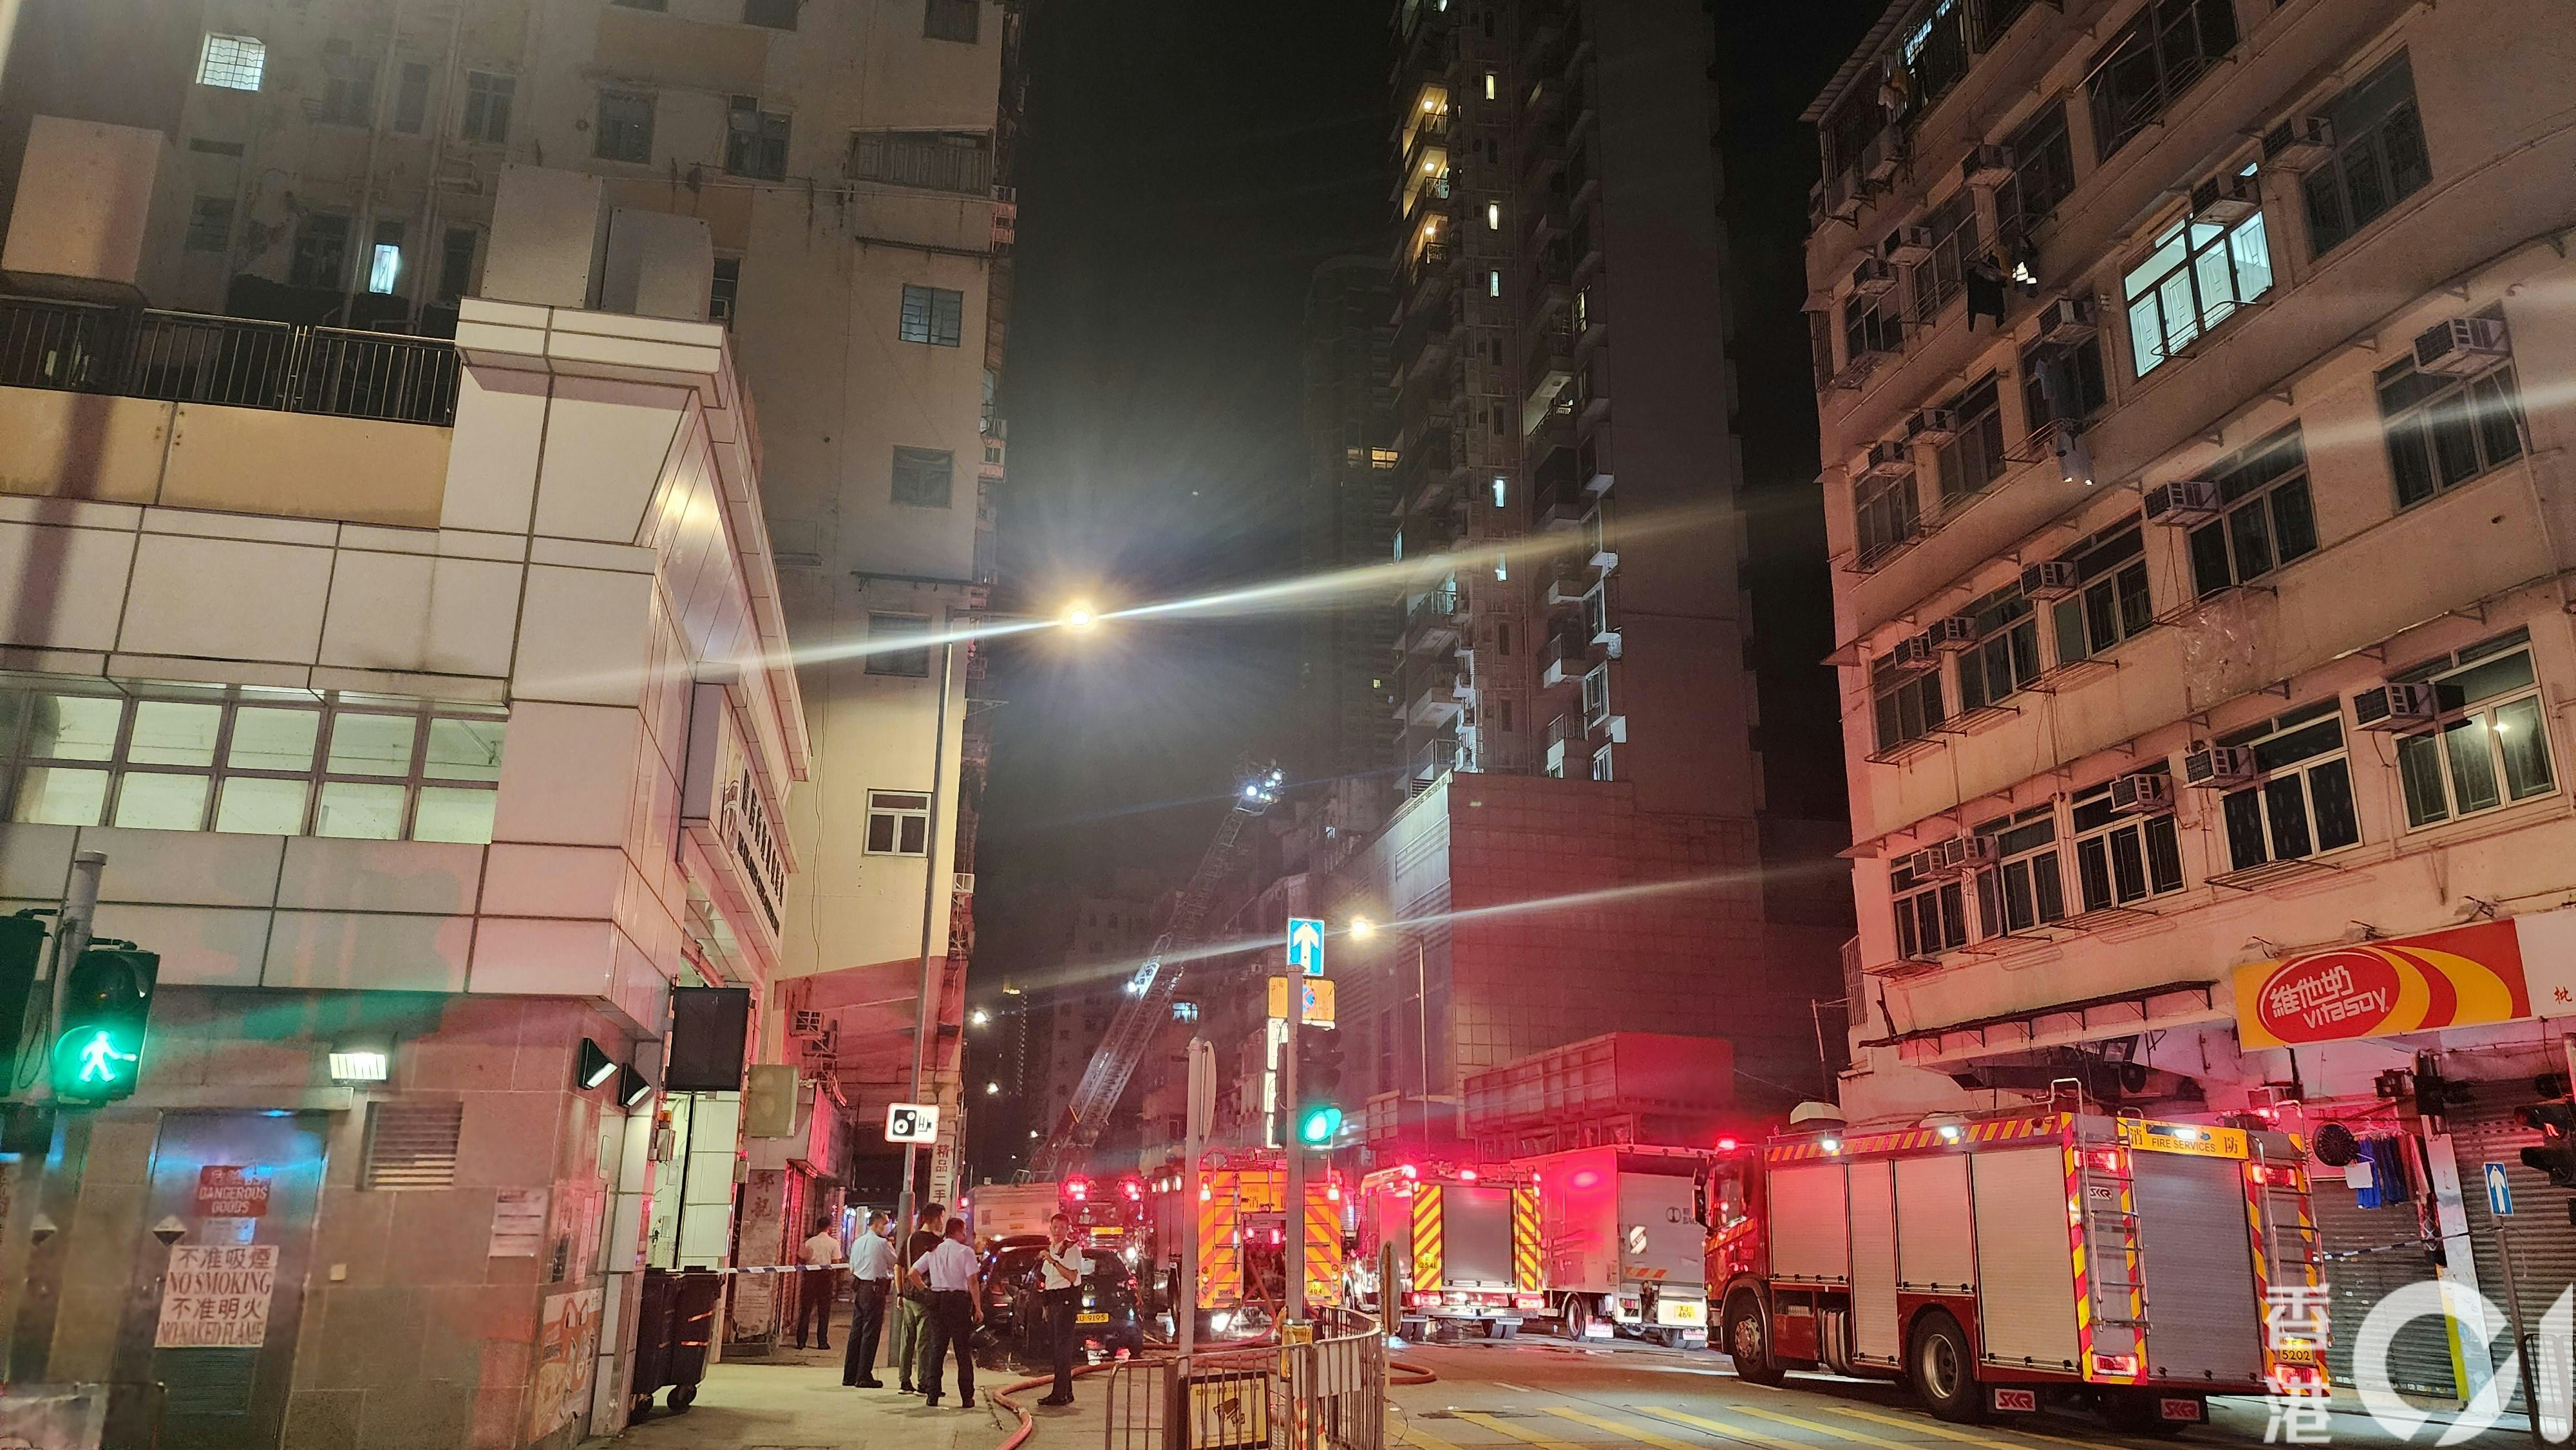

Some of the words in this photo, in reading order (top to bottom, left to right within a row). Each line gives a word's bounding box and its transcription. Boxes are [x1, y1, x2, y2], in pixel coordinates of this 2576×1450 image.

[2270, 965, 2354, 1018] 維他奶
[2303, 986, 2386, 1029] vitasoy
[2130, 1127, 2143, 1145] 消
[2224, 1136, 2238, 1154] 防
[2152, 1138, 2170, 1149] FIRE
[2174, 1140, 2216, 1153] SERVICES
[933, 1144, 950, 1203] 精品二手
[198, 1187, 268, 1201] DANGEROUS
[211, 1201, 251, 1214] GOODS
[178, 1247, 272, 1270] 不准吸煙
[168, 1271, 192, 1295] NO
[194, 1271, 272, 1295] SMOKING
[171, 1297, 263, 1320] 不准明火
[160, 1321, 178, 1346] NO
[222, 1321, 264, 1345] FLAME
[2282, 1350, 2311, 1361] 5202
